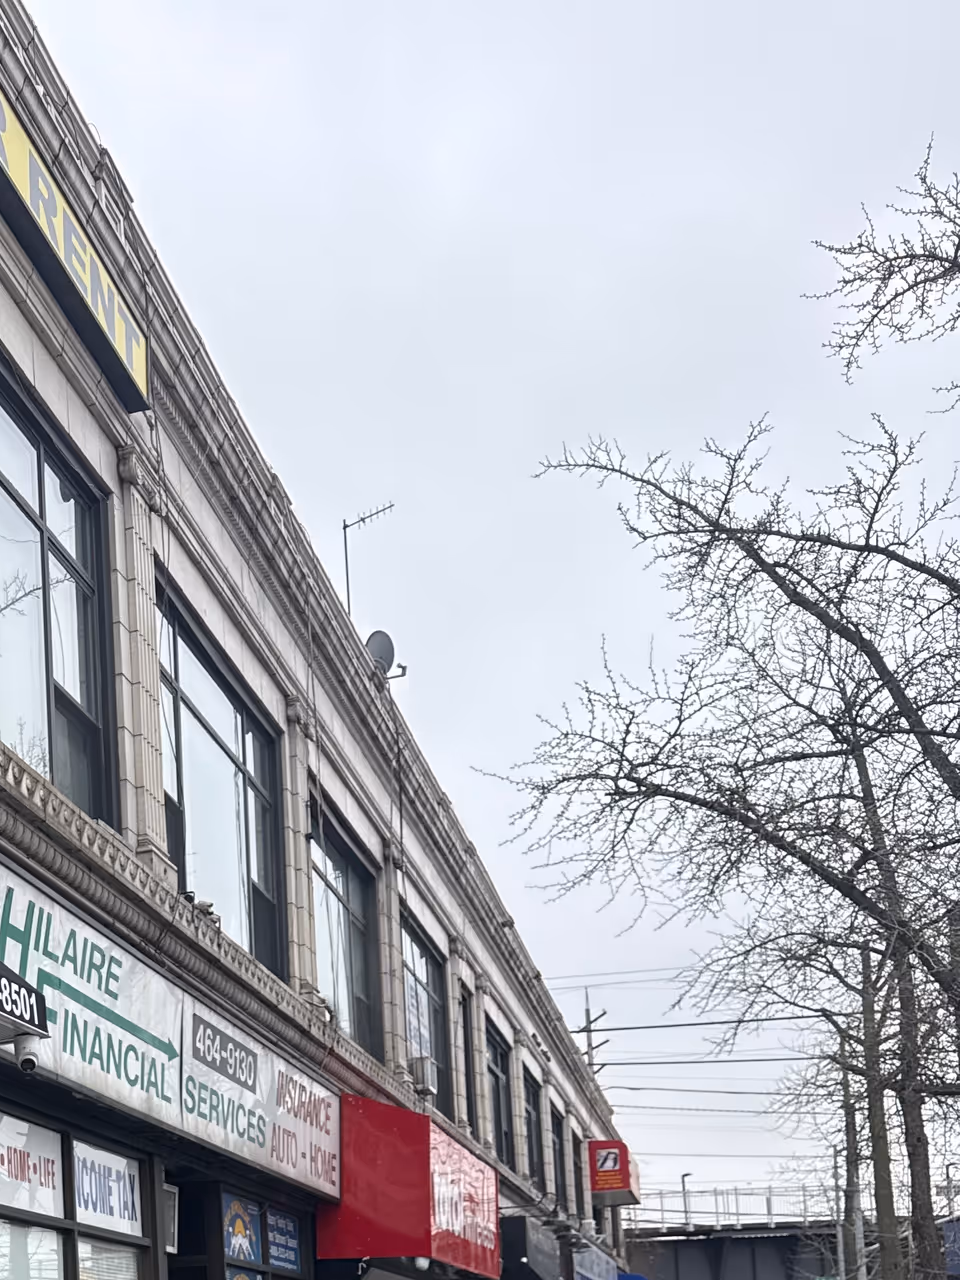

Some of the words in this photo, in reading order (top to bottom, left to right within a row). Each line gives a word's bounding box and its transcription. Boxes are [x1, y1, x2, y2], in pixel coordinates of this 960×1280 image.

[28, 146, 142, 373] RENT
[36, 966, 173, 1105] FINANCIAL
[183, 1074, 267, 1149] SERVICES
[195, 1023, 256, 1088] 464-9130
[275, 1069, 332, 1136] INSURANCE
[6, 1145, 31, 1184] HOME
[38, 1155, 57, 1191] LIFE
[74, 1153, 114, 1217] NCOME
[116, 1166, 139, 1222] TAX
[270, 1122, 298, 1170] AUTO
[309, 1141, 337, 1188] HOME
